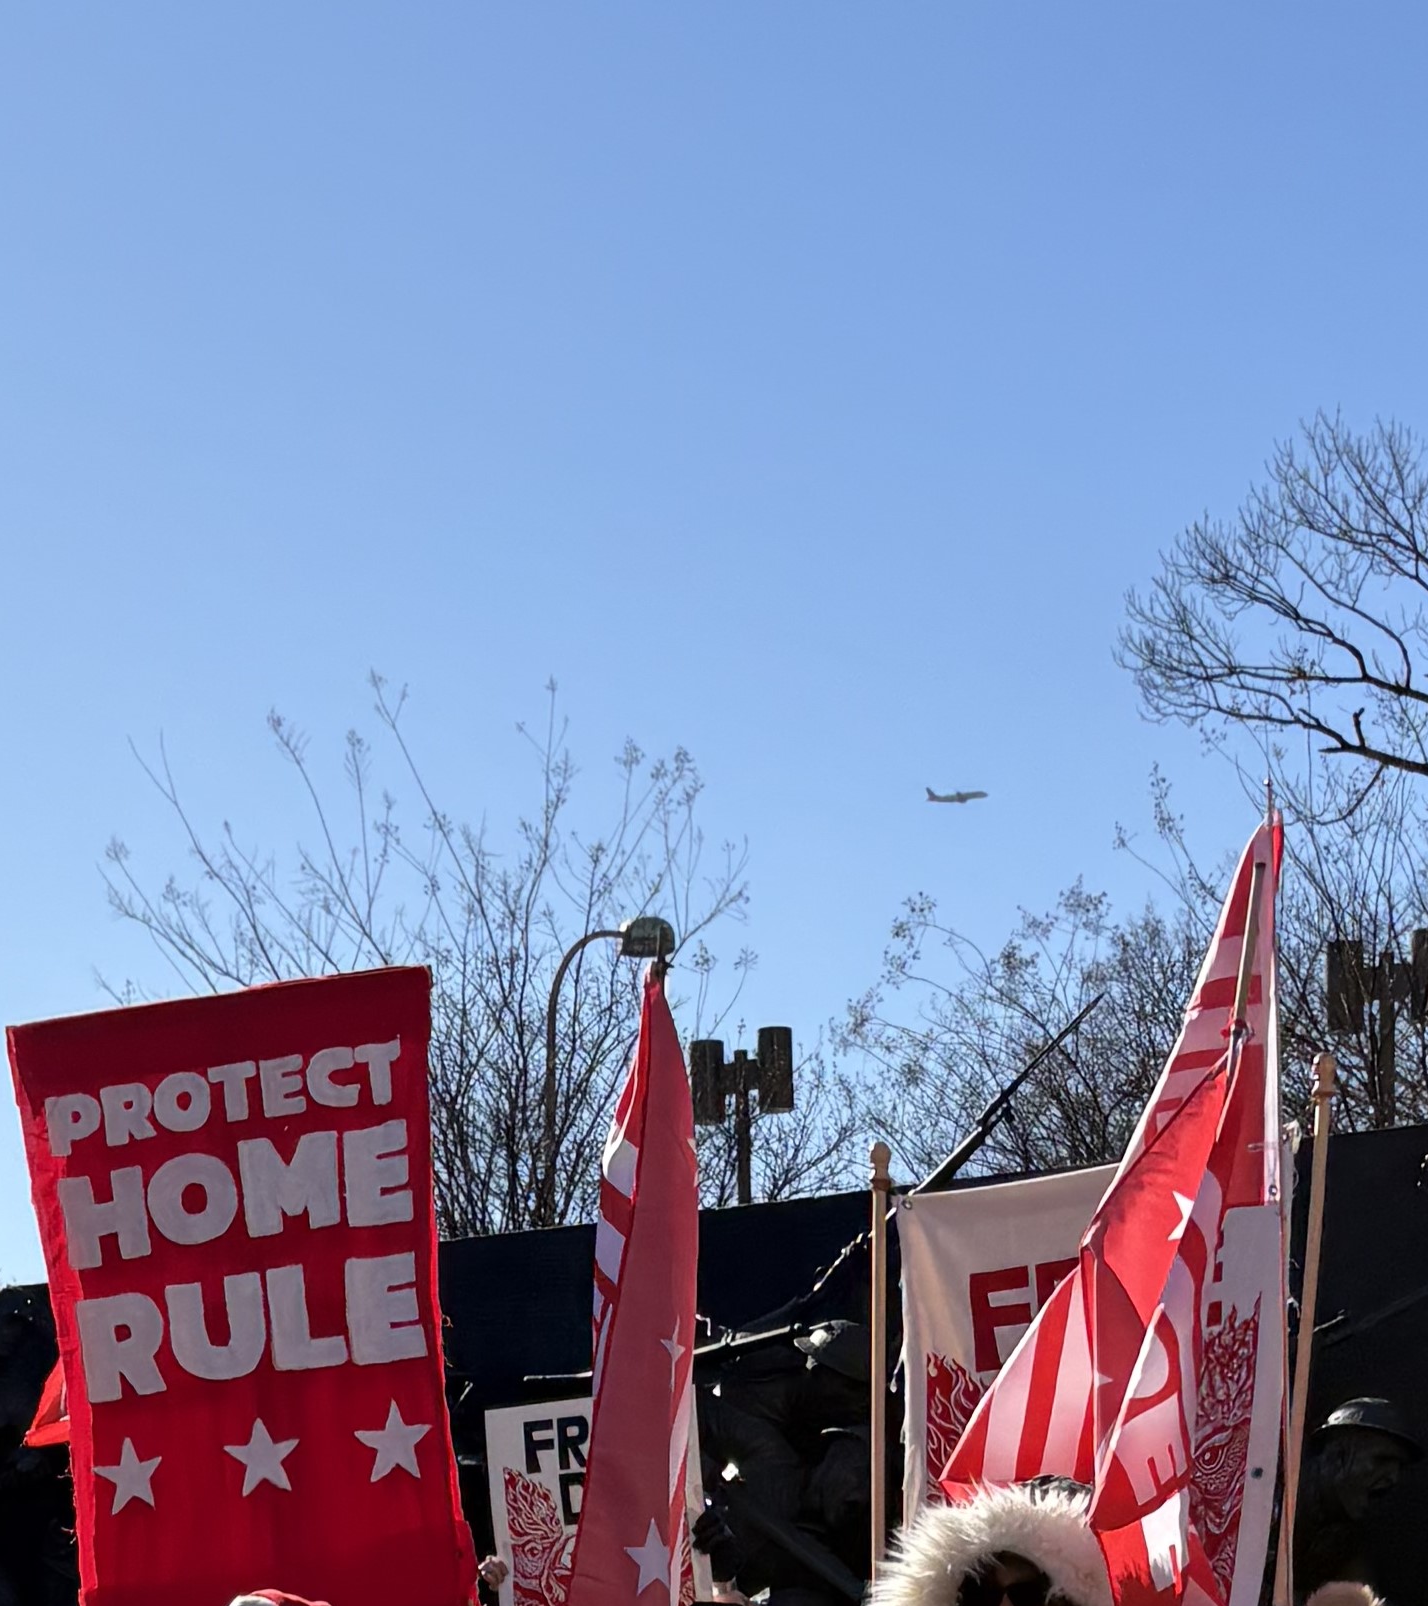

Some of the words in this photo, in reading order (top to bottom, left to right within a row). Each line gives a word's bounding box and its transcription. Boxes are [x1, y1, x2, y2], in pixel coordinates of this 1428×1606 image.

[44, 1036, 400, 1157] PROTECT
[58, 1119, 413, 1270] HOME
[77, 1251, 428, 1403] RULE
[523, 1415, 589, 1474] FR
